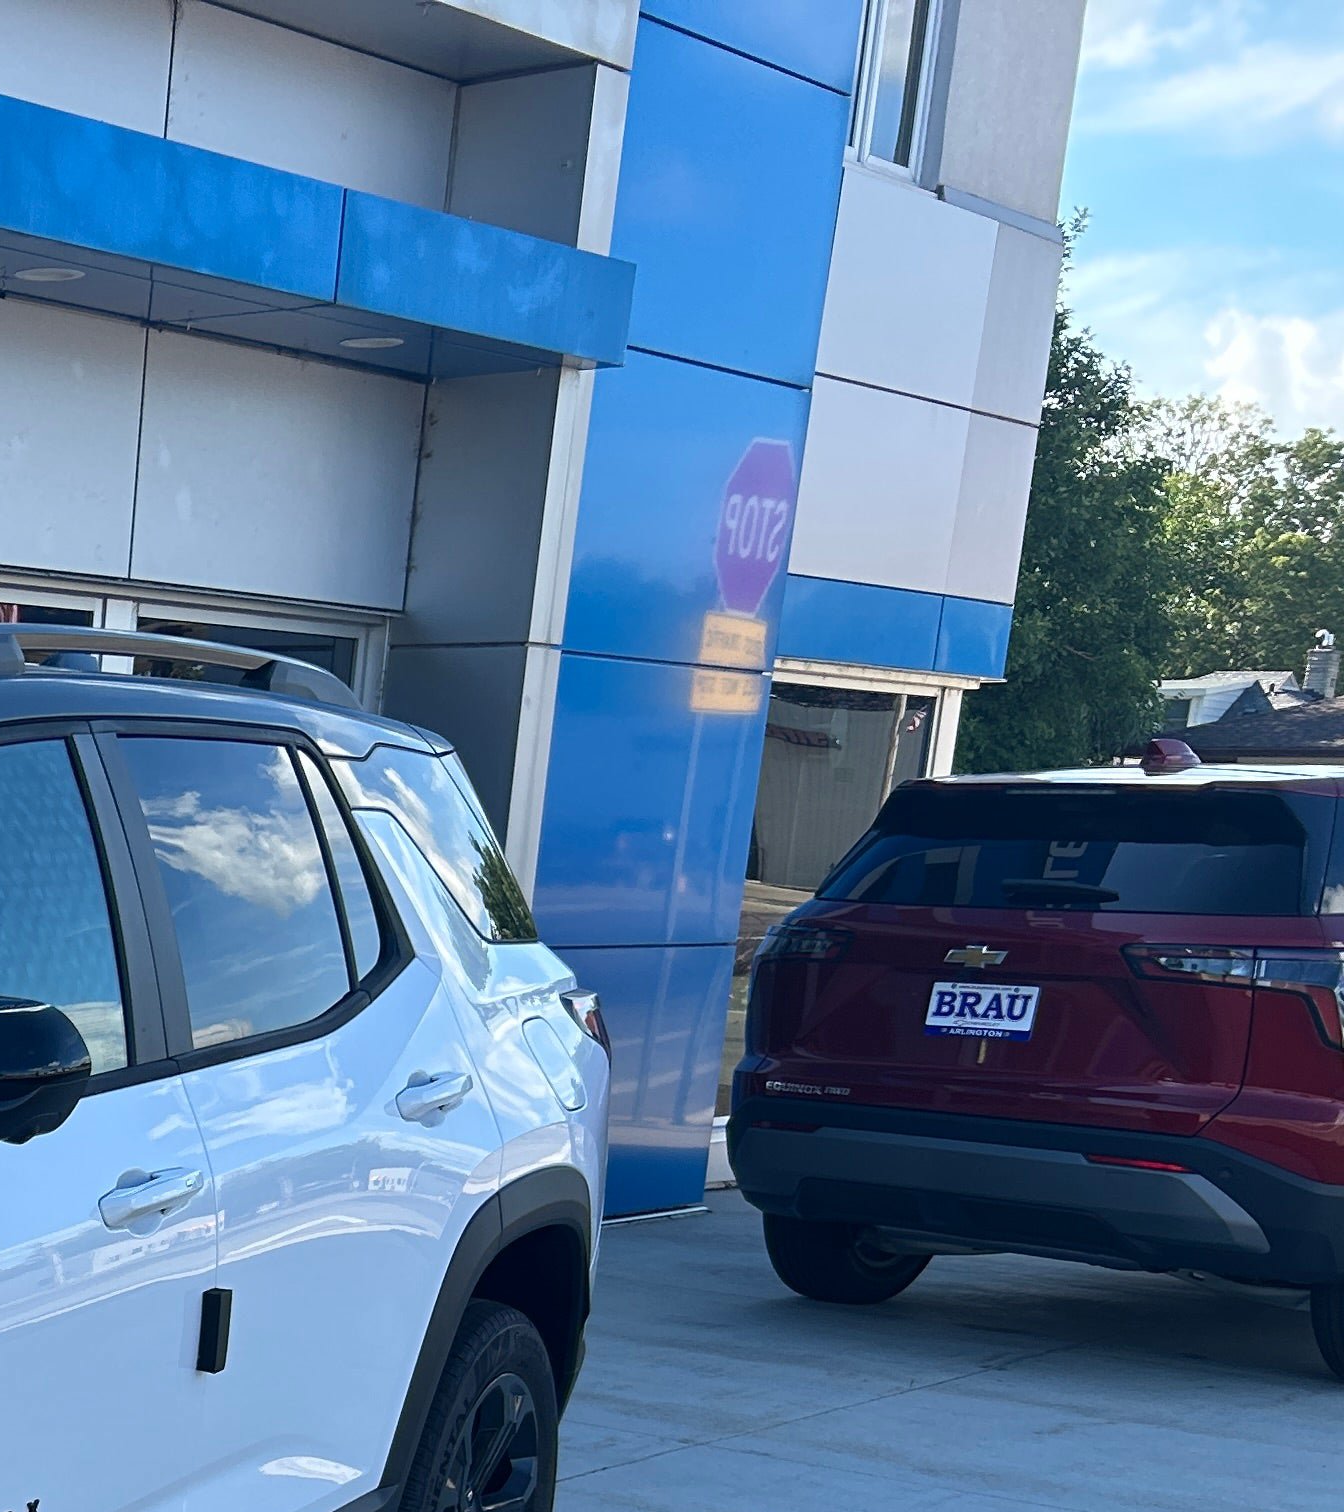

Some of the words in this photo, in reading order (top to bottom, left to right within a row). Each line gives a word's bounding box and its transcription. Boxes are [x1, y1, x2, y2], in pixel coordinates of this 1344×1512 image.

[931, 990, 1033, 1022] BRAU
[949, 1028, 1003, 1037] ARLINGTON
[765, 1081, 822, 1095] EQUINOX
